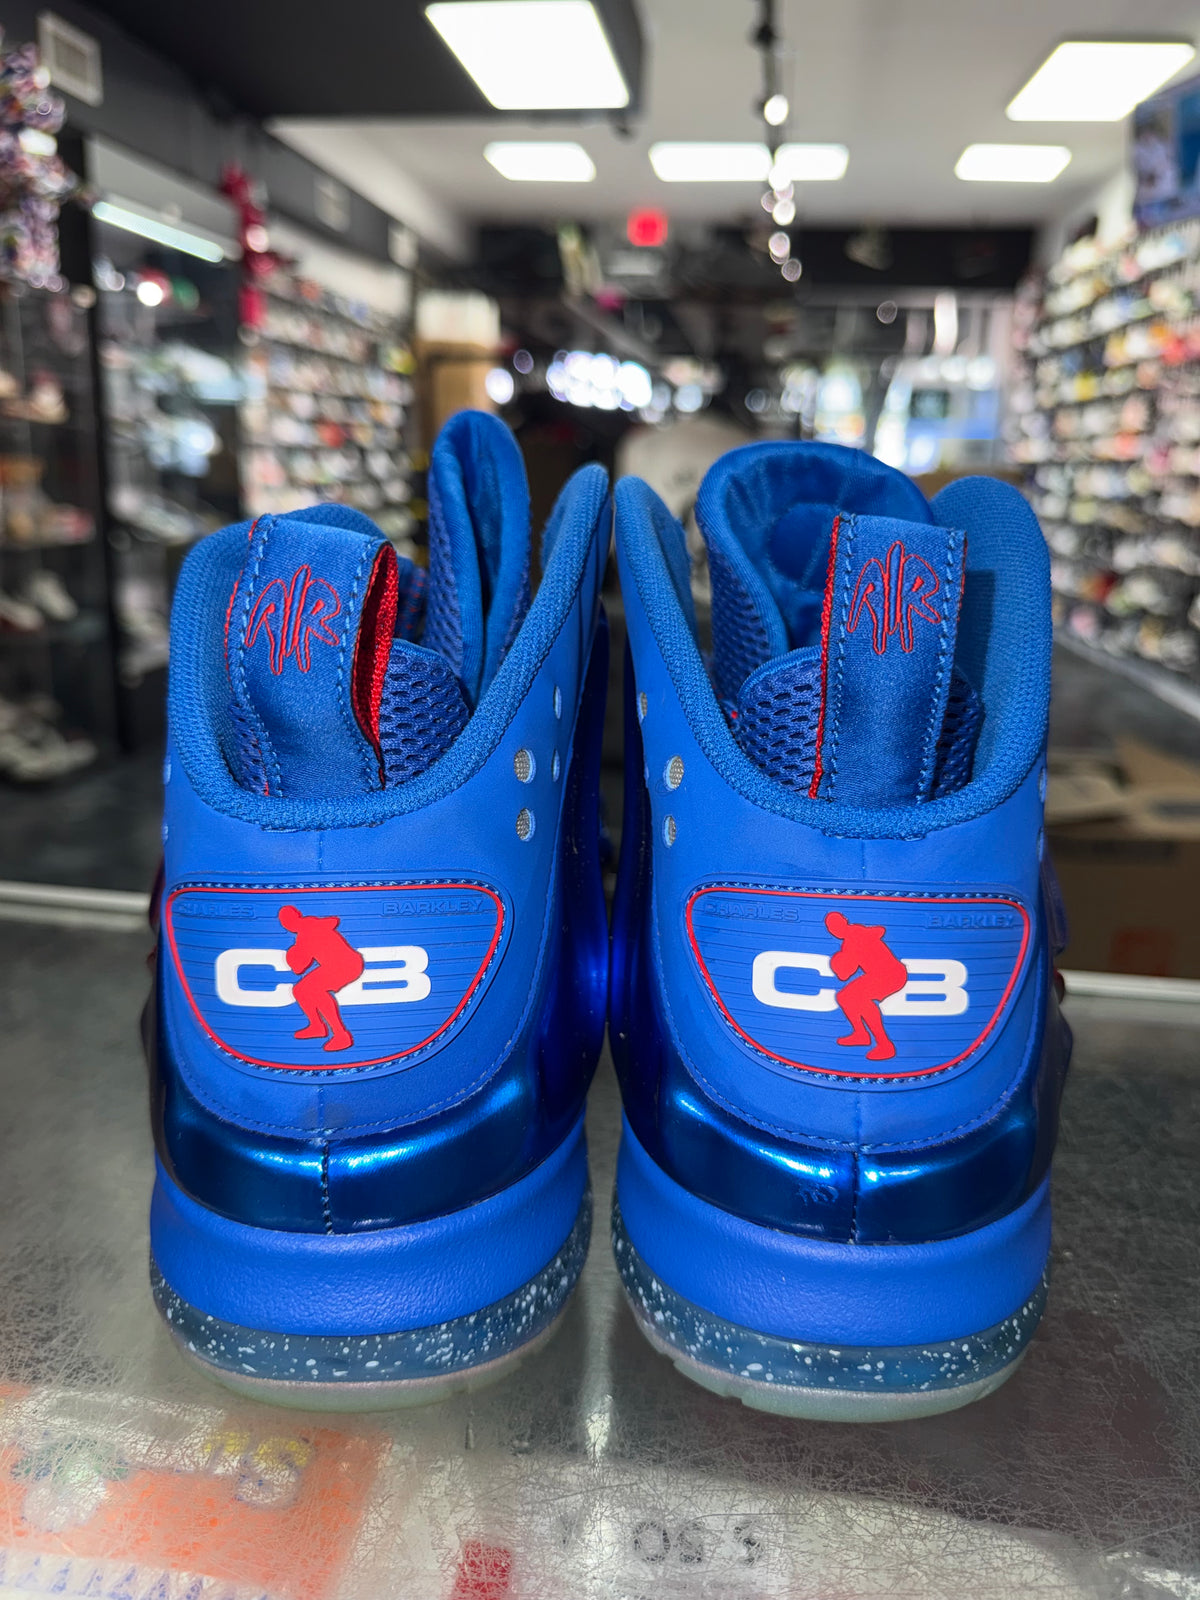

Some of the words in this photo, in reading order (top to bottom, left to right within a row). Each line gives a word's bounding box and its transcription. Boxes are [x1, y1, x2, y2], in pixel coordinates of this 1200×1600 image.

[383, 898, 483, 915] BARKLEY
[703, 902, 799, 922] CHARLES
[927, 913, 1014, 929] BARKLEY
